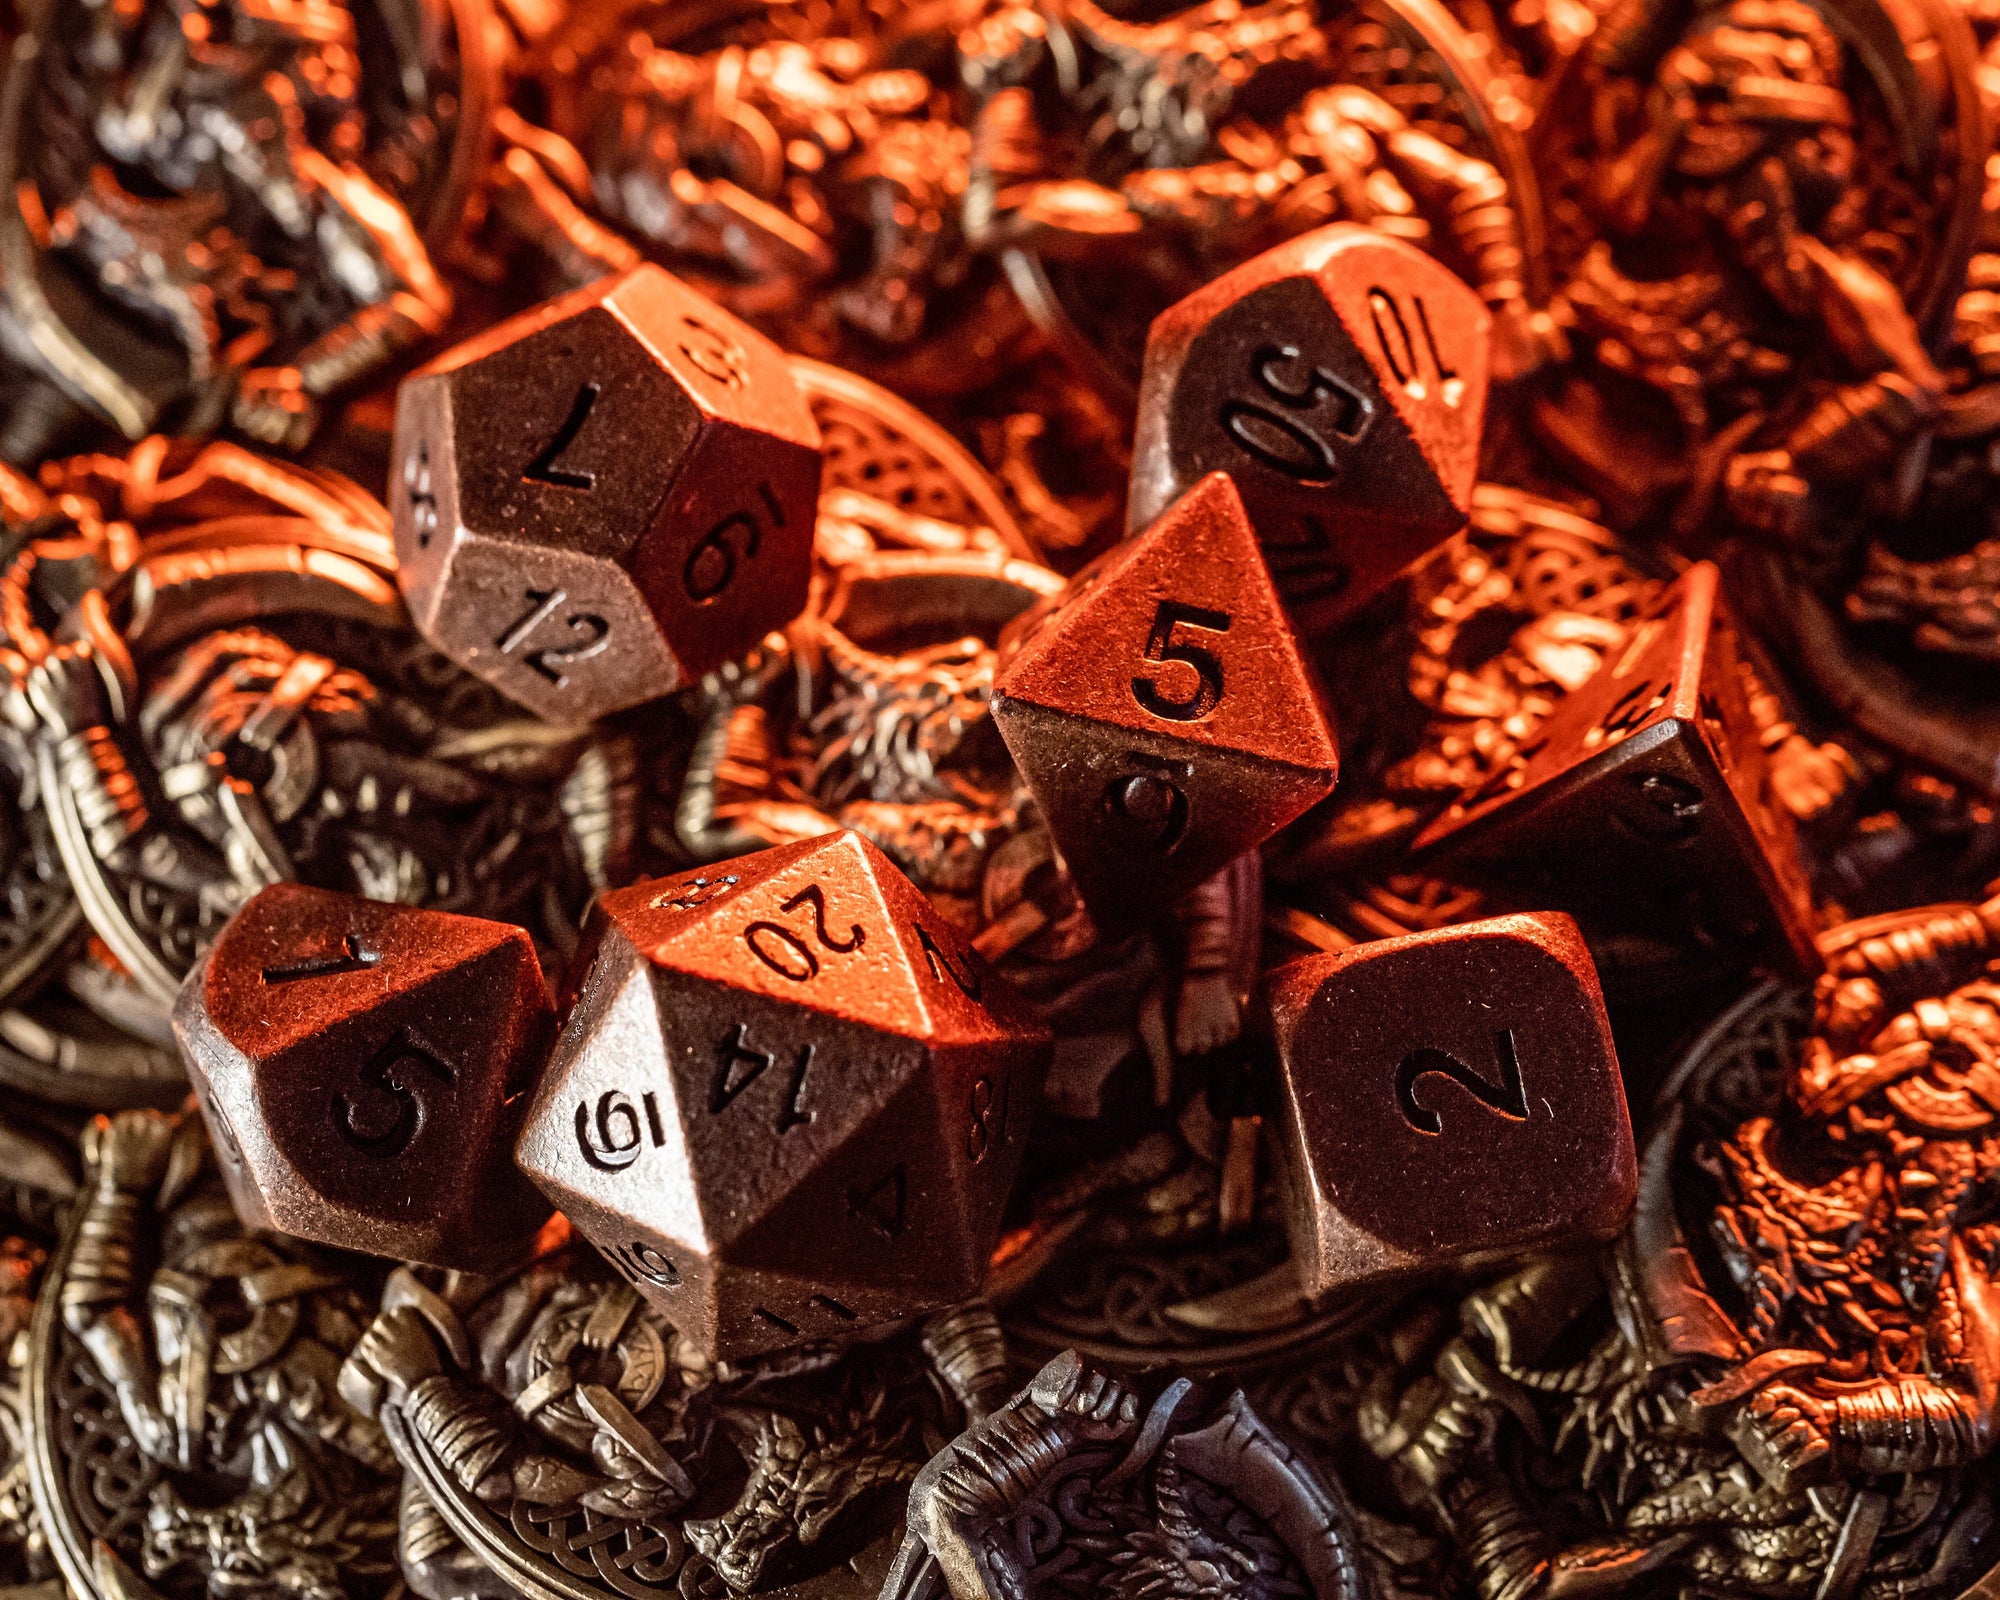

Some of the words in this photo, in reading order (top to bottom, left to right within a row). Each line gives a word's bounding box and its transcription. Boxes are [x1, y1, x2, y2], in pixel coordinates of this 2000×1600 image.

[1367, 286, 1464, 407] 10
[522, 382, 600, 492] 7
[1220, 344, 1374, 488] 50
[495, 587, 611, 690] 12
[1131, 600, 1233, 724] 5
[743, 883, 867, 983] 20
[331, 1028, 460, 1159] 5
[710, 1022, 818, 1136] 14
[1394, 1028, 1530, 1137] 2
